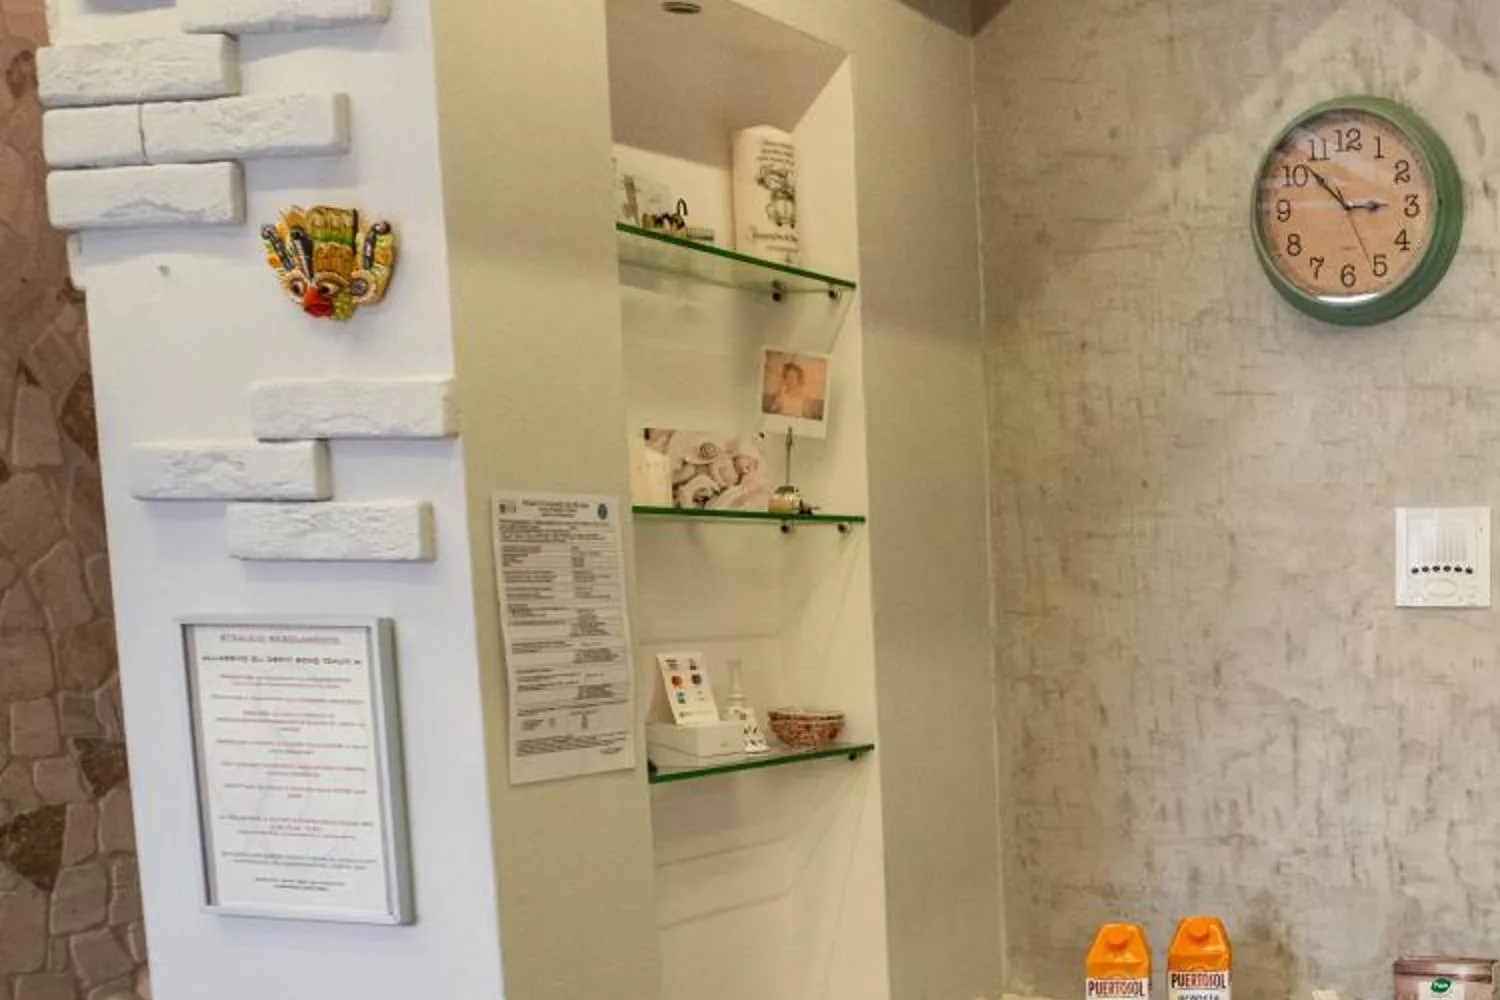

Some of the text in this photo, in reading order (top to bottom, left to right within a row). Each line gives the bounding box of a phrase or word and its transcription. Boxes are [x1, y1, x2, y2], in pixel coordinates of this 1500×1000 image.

[1308, 138, 1331, 162] 11
[1334, 128, 1362, 153] 12
[1373, 135, 1385, 159] 1
[1282, 164, 1309, 188] 10
[1393, 159, 1411, 184] 2
[1276, 199, 1291, 223] 9
[1404, 193, 1421, 218] 3
[1286, 233, 1303, 257] 8
[1394, 229, 1411, 251] 4
[1309, 256, 1325, 279] 7
[1340, 264, 1357, 288] 6
[1372, 254, 1388, 277] 5
